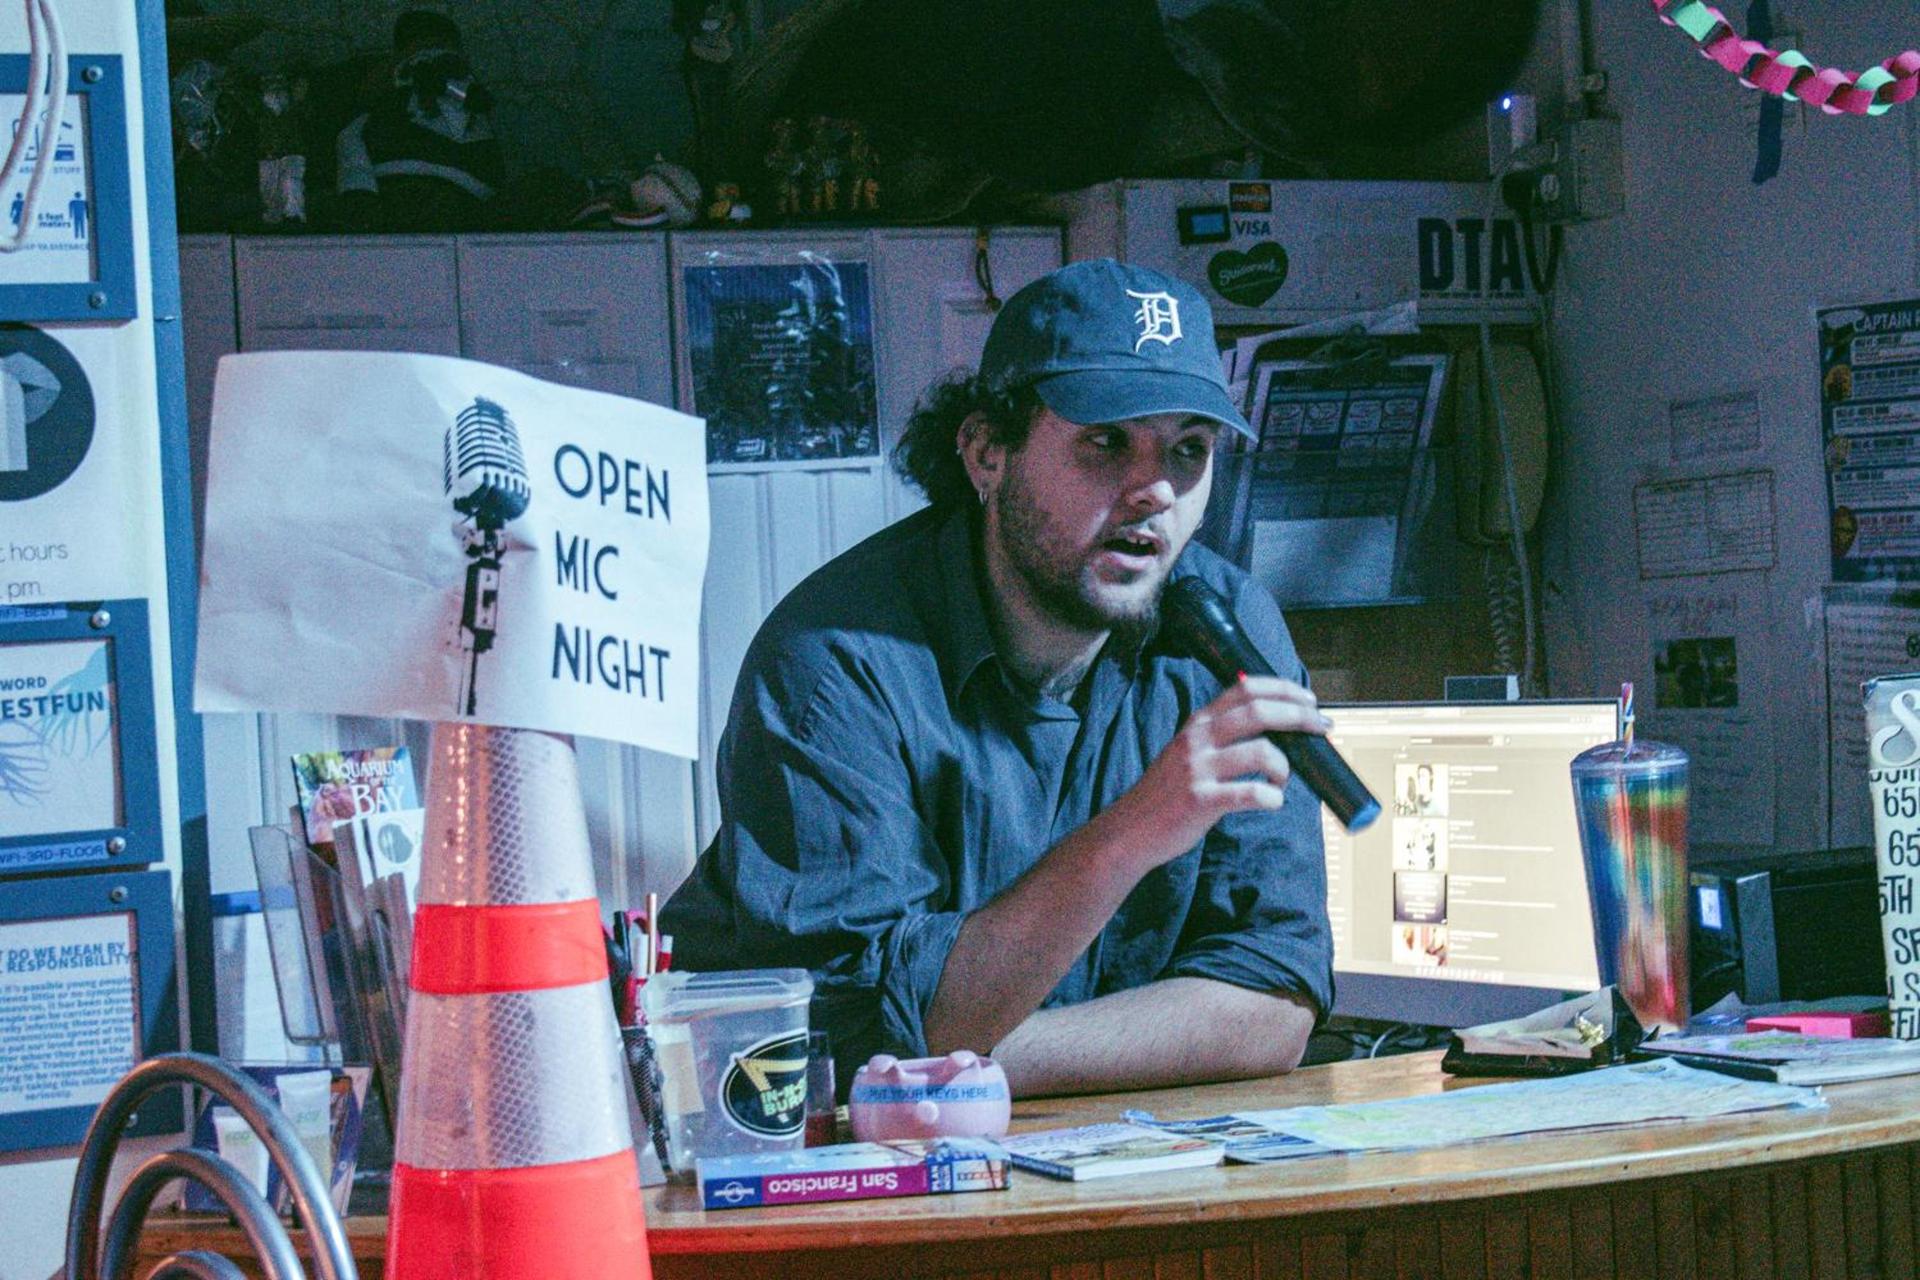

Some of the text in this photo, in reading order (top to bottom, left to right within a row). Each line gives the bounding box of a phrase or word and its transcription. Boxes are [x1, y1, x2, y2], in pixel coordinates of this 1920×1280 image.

[1234, 219, 1271, 236] VISA
[1126, 289, 1183, 353] D
[554, 443, 671, 522] OPEN
[10, 541, 69, 562] hours
[555, 530, 619, 601] MIC
[8, 579, 41, 601] pm
[551, 623, 670, 702] NIGHT
[1, 676, 47, 691] WORD
[2, 691, 105, 720] ESTFUN
[326, 758, 404, 783] AQUARIUM
[352, 784, 404, 818] BAY
[8, 941, 125, 961] DO WE MEAN BY
[7, 952, 130, 973] RESPONSIBILITY
[926, 1086, 960, 1098] KEYS
[961, 1086, 989, 1098] HERE
[768, 1175, 857, 1196] Francisco
[861, 1171, 899, 1190] San
